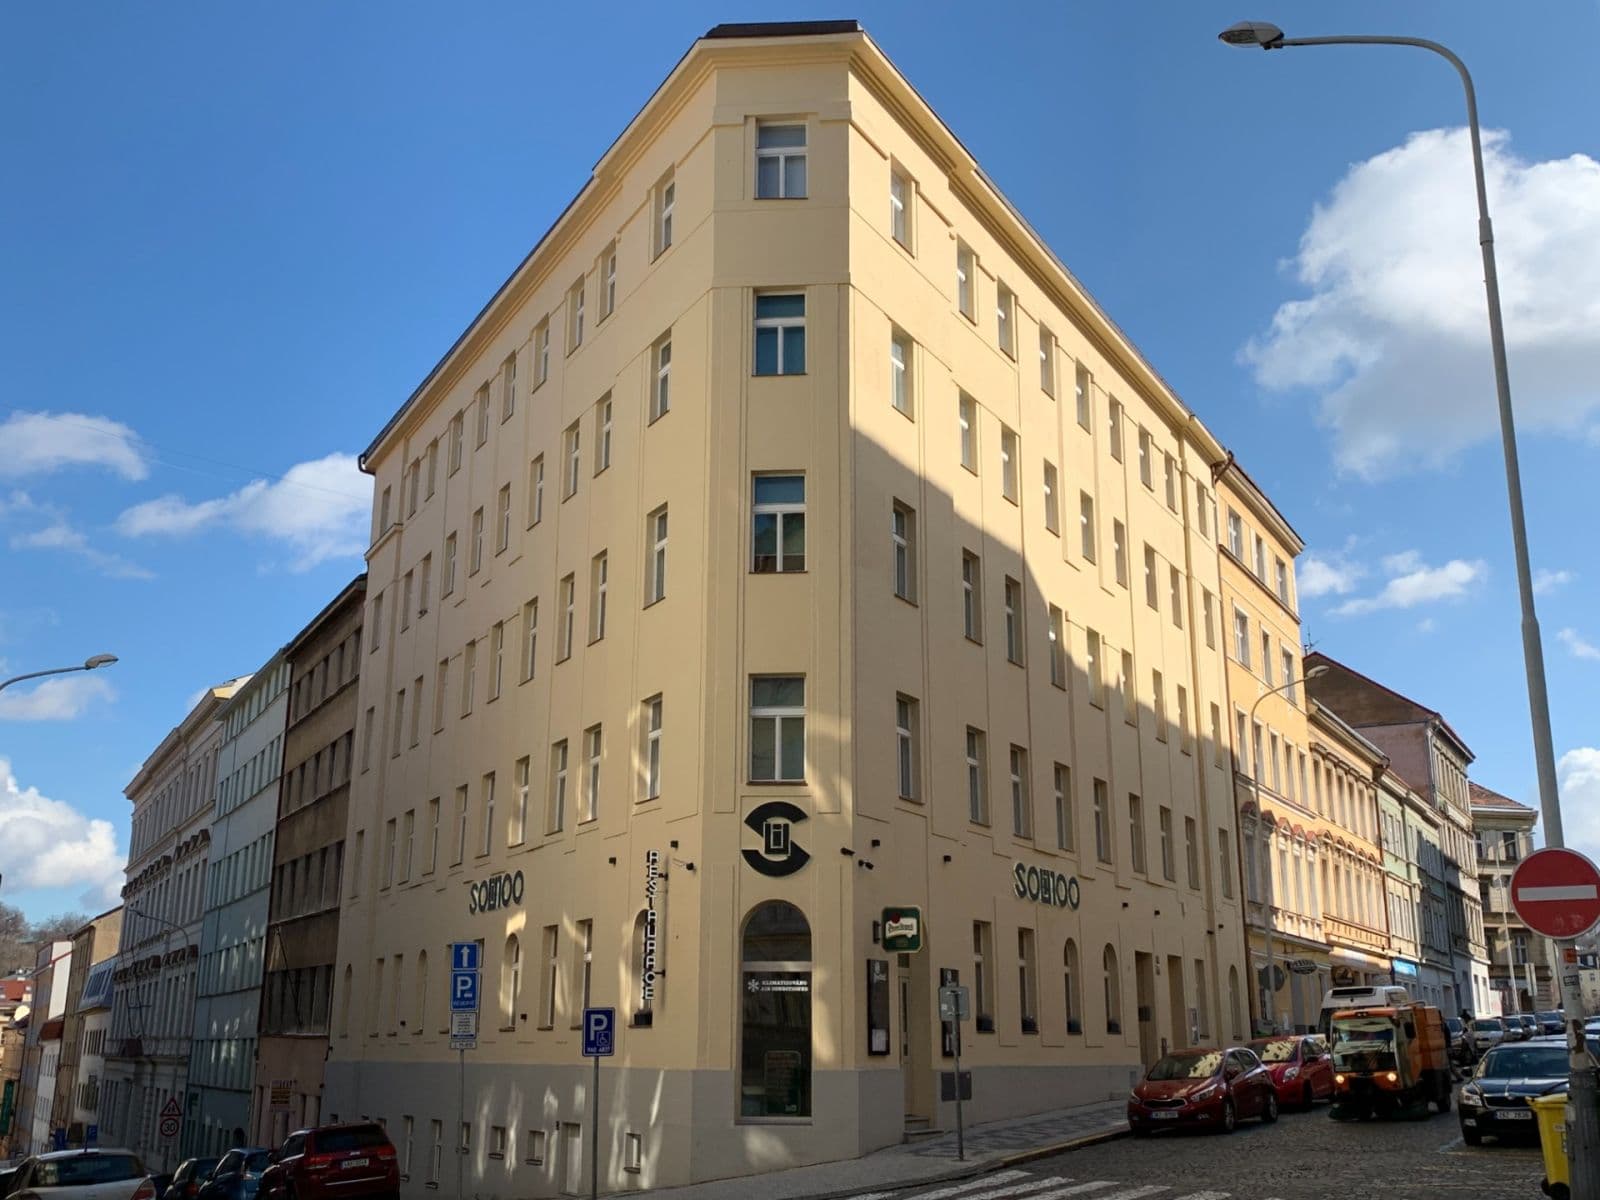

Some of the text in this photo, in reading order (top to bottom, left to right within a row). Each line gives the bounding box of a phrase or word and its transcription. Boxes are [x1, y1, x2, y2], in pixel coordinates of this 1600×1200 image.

[456, 975, 472, 998] P
[590, 1014, 608, 1041] P
[164, 1122, 176, 1133] 30
